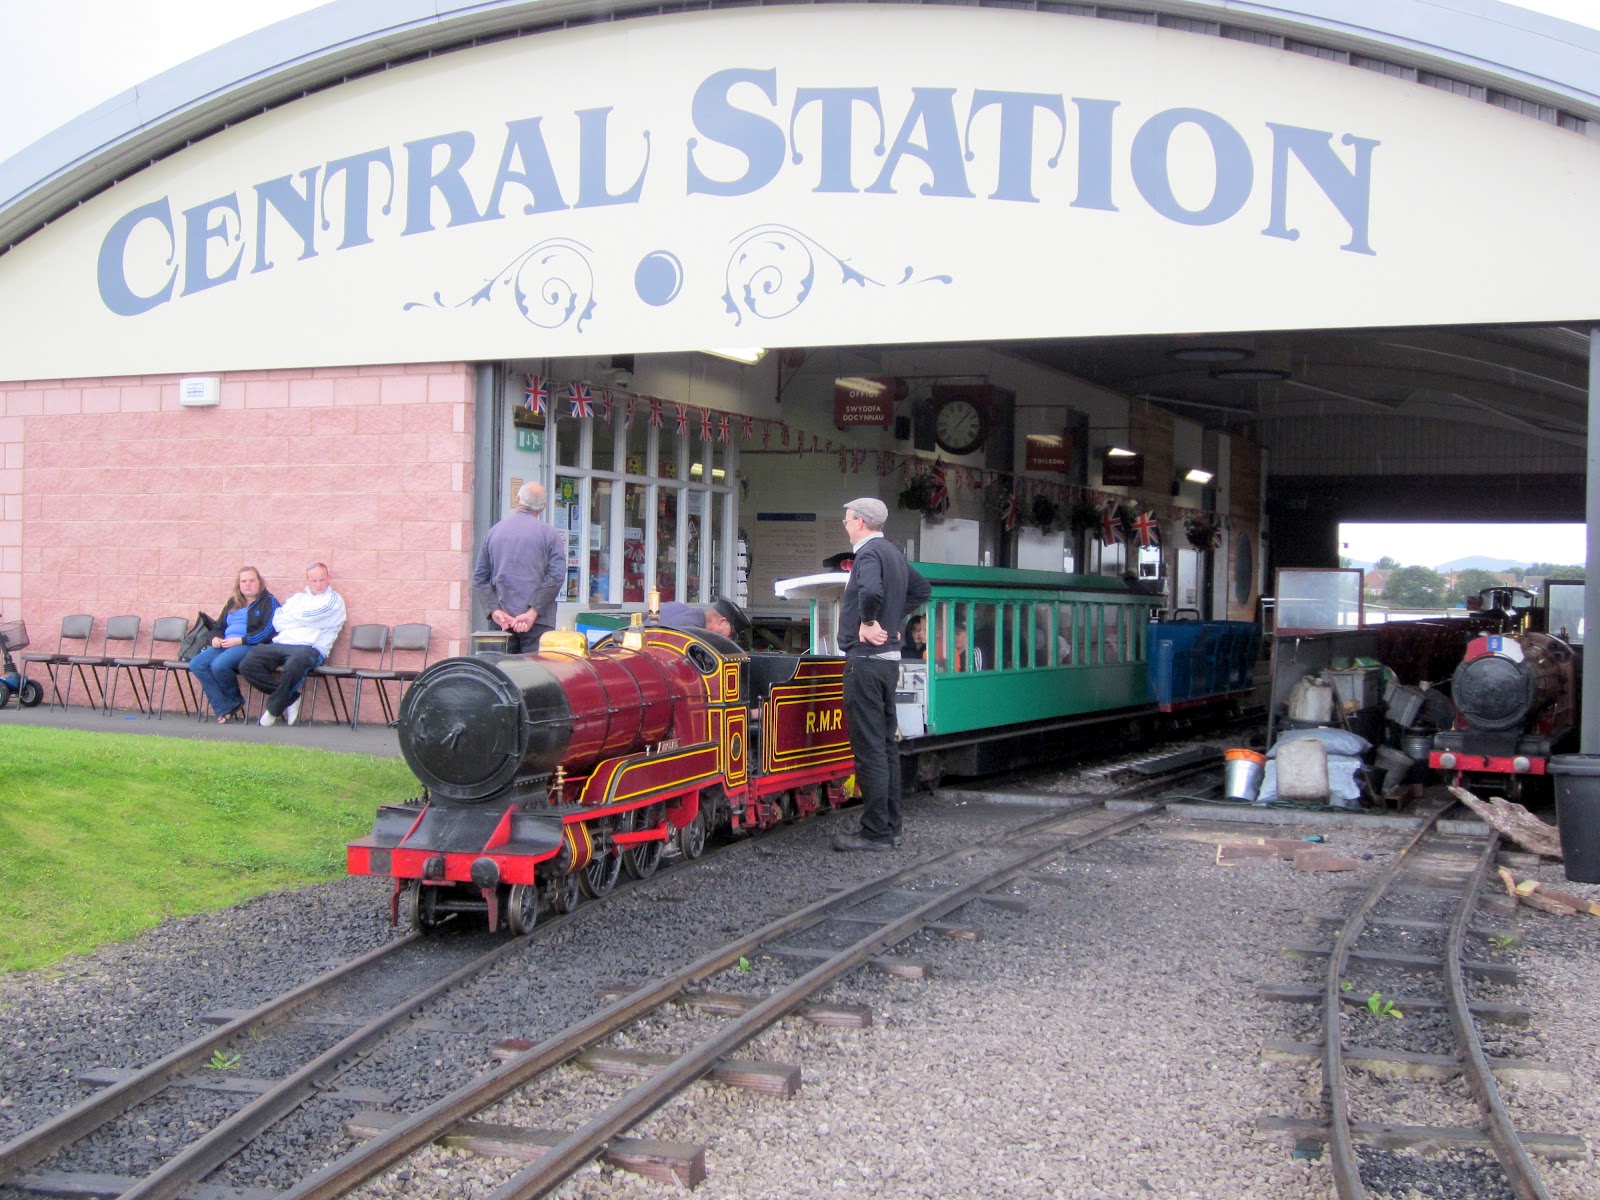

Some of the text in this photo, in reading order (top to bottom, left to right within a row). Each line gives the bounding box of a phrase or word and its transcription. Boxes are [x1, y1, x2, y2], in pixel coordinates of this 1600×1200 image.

[97, 66, 1382, 317] CENTRAL STATION
[846, 405, 881, 413] SWYDDFA
